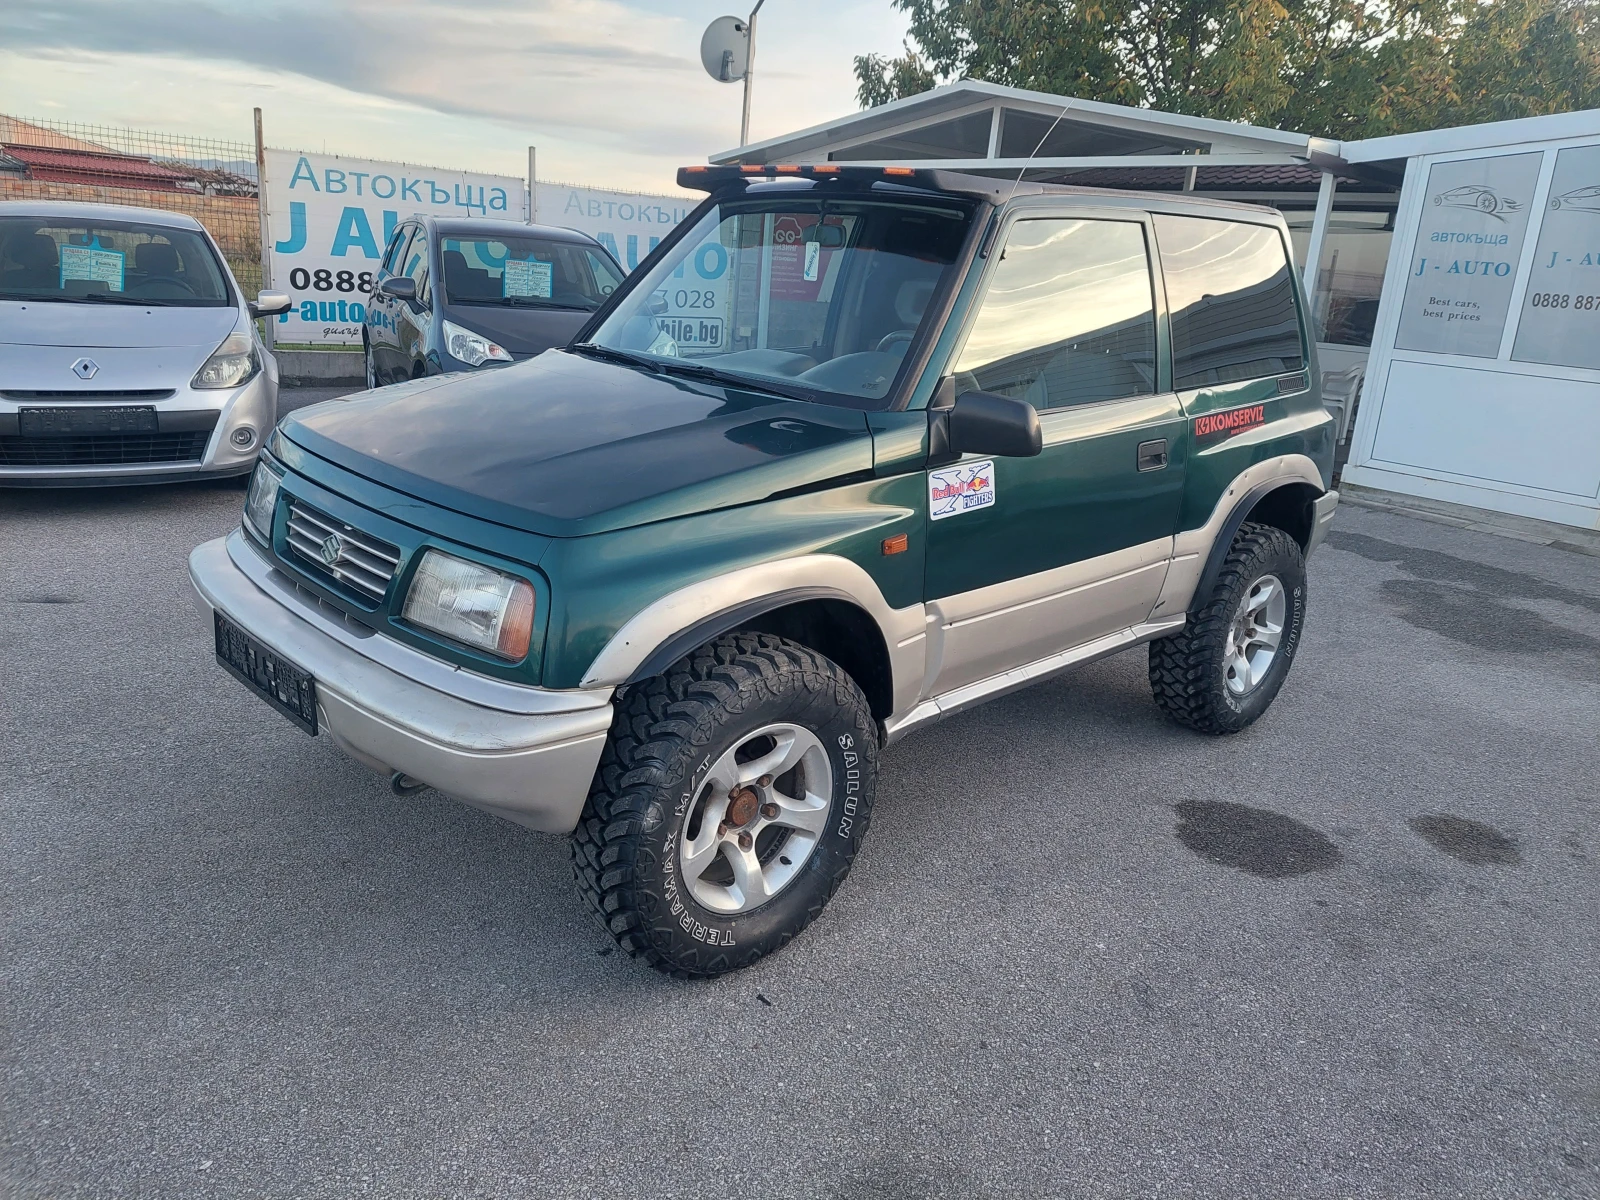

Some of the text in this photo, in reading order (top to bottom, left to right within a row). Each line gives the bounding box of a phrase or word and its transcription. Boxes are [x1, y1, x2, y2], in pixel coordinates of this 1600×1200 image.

[288, 156, 508, 216] Автокъща
[563, 190, 695, 226] Автокъщ
[275, 201, 307, 254] J
[1430, 231, 1509, 247] автокъща
[590, 231, 728, 280] AUO
[1546, 251, 1559, 268] J
[1414, 258, 1427, 277] J
[1446, 260, 1512, 277] AUTO
[289, 267, 374, 294] 0888
[674, 289, 715, 309] 028
[1428, 296, 1481, 310] Best cars,
[1532, 292, 1570, 309] 0888
[1423, 308, 1482, 322] best prices
[660, 319, 720, 345] bile.bg
[1209, 405, 1264, 433] KOMSERVIZ
[931, 482, 965, 501] Red Bull
[963, 491, 993, 509] FIGHTERS
[838, 733, 860, 839] SAILUN
[662, 830, 736, 946] TERRAMAX
